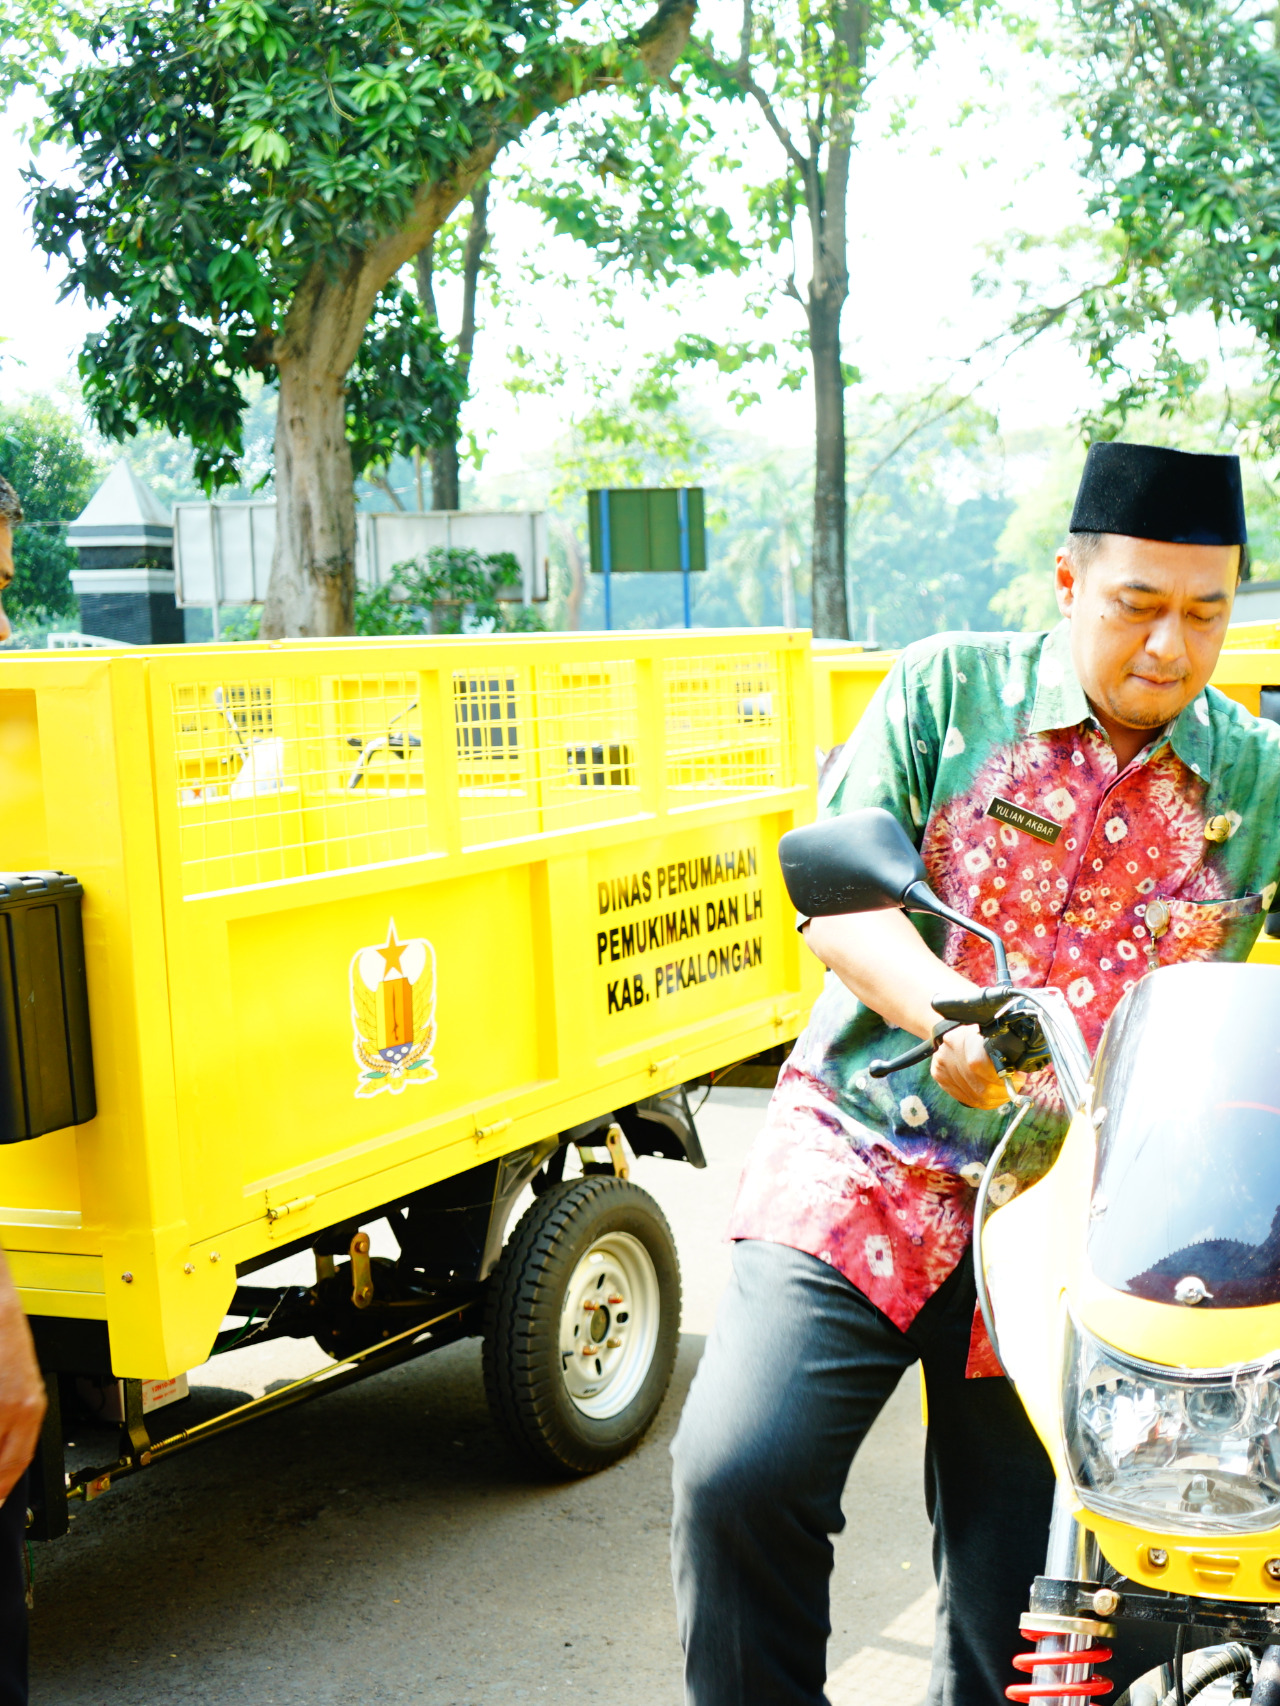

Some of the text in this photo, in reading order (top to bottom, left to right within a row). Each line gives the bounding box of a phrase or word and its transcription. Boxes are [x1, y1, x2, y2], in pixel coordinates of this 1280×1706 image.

[996, 804, 1054, 836] YULIAN AKBAR
[598, 847, 757, 915] DINAS PERUMAHAN
[597, 889, 763, 965] PEMUKIMAN DAN LH
[607, 936, 762, 1015] KAB. PEKALONGAN
